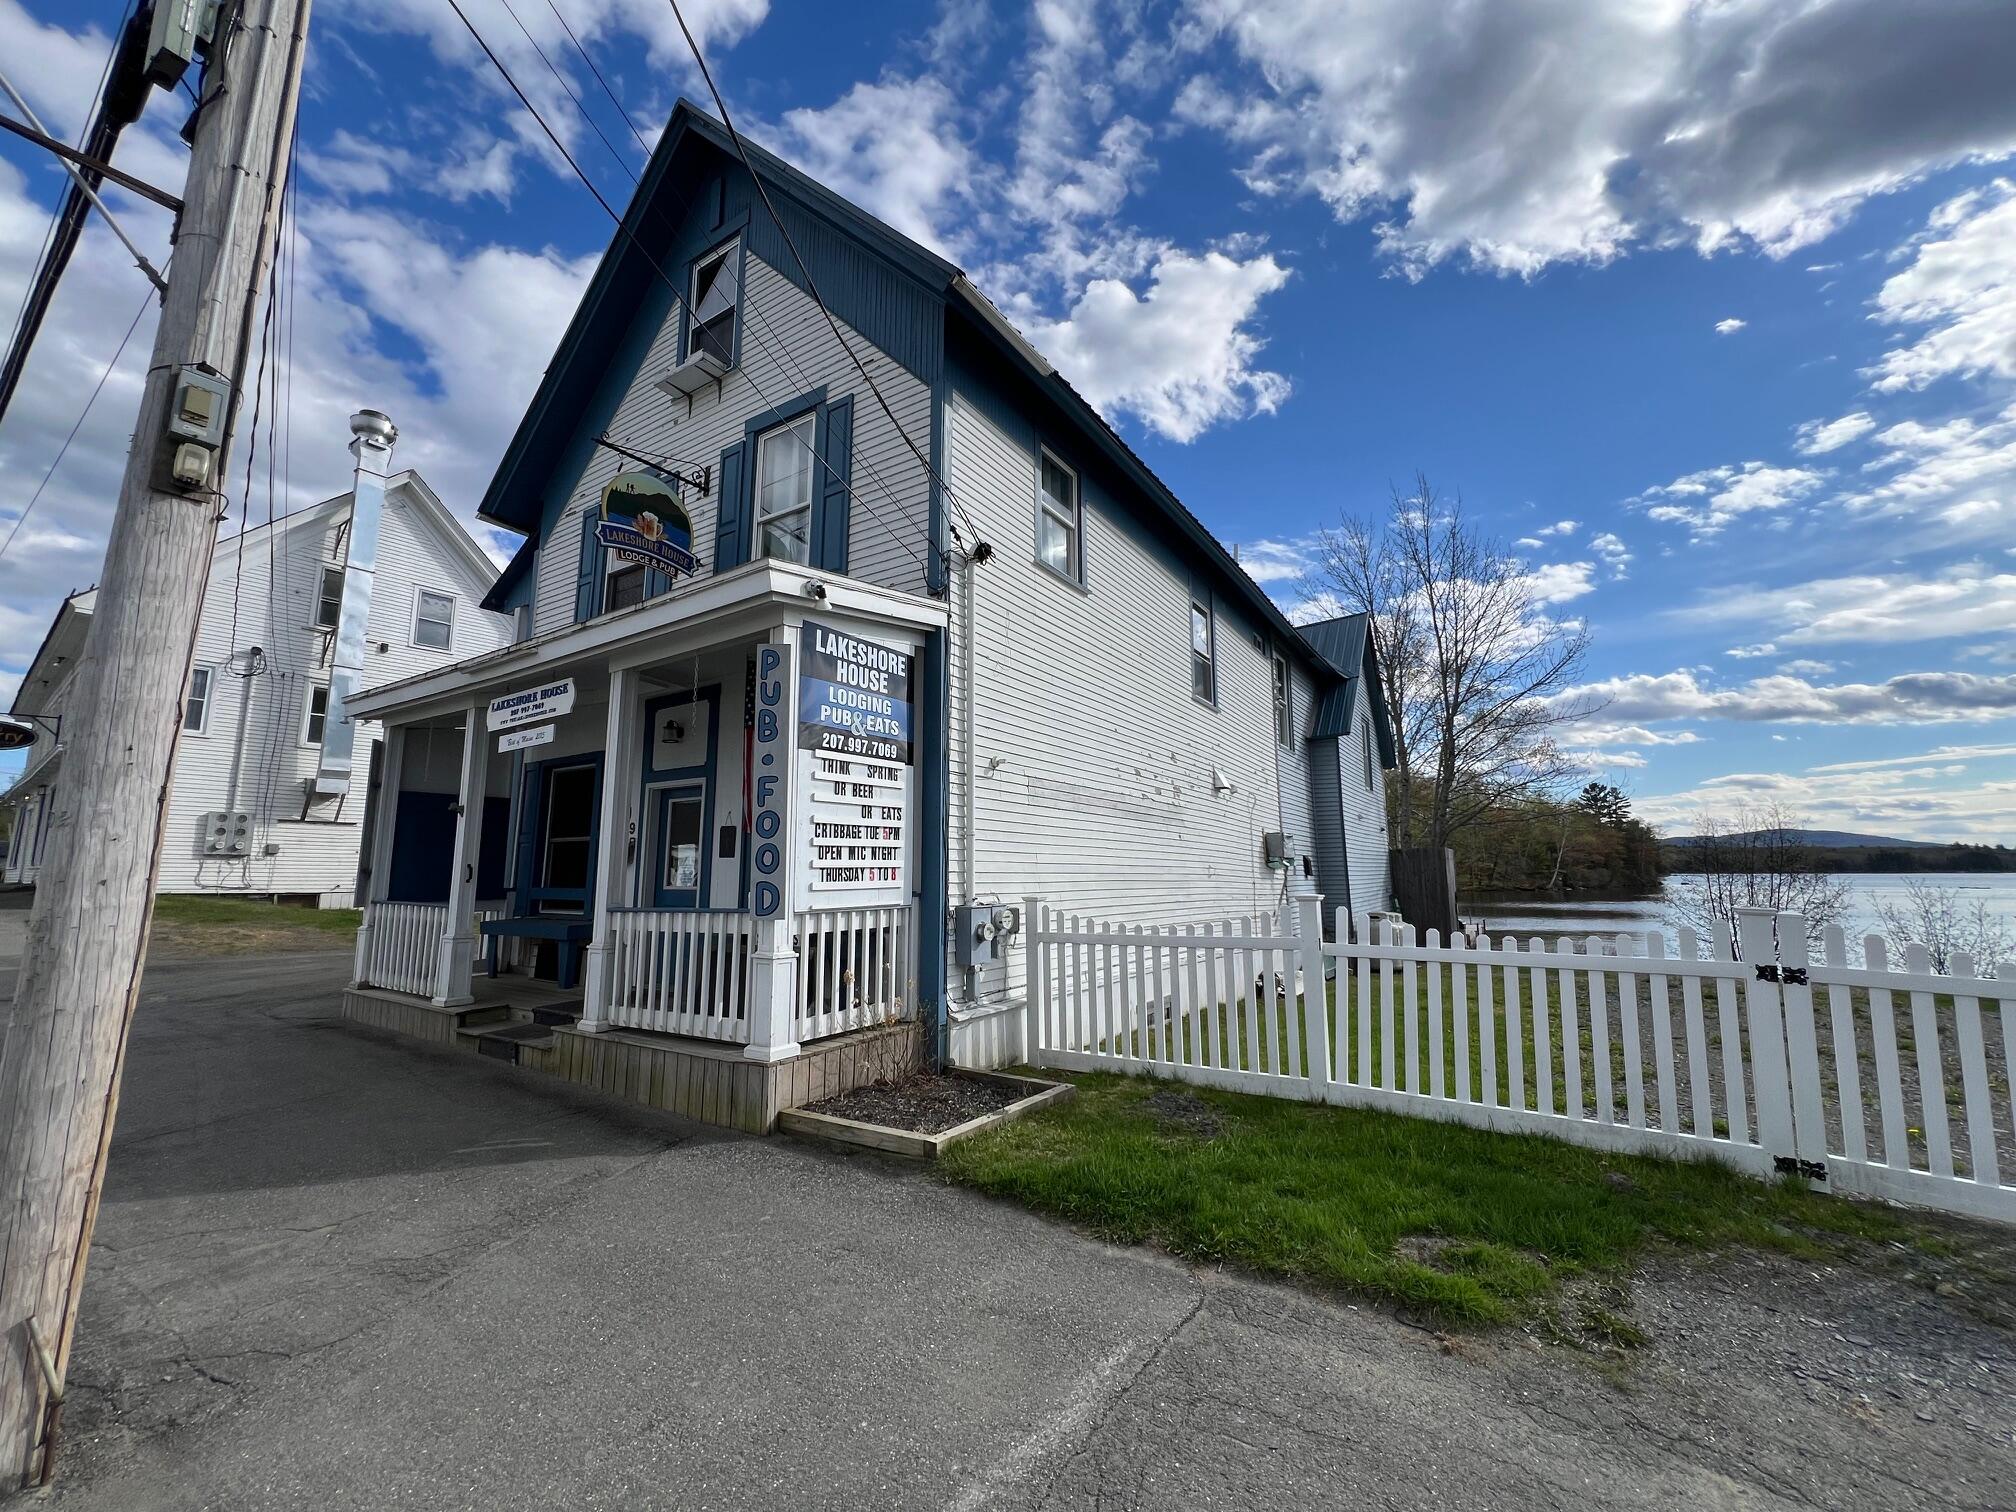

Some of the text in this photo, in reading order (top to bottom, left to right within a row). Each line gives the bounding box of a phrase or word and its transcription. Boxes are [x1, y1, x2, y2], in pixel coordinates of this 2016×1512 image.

[606, 528, 690, 567] LAKESHORE HOUSE
[620, 551, 676, 576] LODGE & PUB
[815, 629, 906, 677] LAKESHORE
[836, 660, 889, 694] HOUSE
[491, 683, 568, 712] LAKESHORE HOUSE
[829, 686, 892, 715] LODGING
[820, 705, 900, 737] PUB & EATS
[822, 732, 897, 758] 207.997.7069
[755, 649, 781, 917] PUB FOOD
[822, 759, 898, 781] THINK SPRING
[834, 781, 873, 799] OR BEER
[861, 805, 902, 821] OR EATS
[814, 823, 900, 841] CRIBBAGE TUE 5PM
[818, 845, 897, 860] OPEN MIC NIGHT
[820, 867, 897, 882] THURSDAY 5 TO 8
